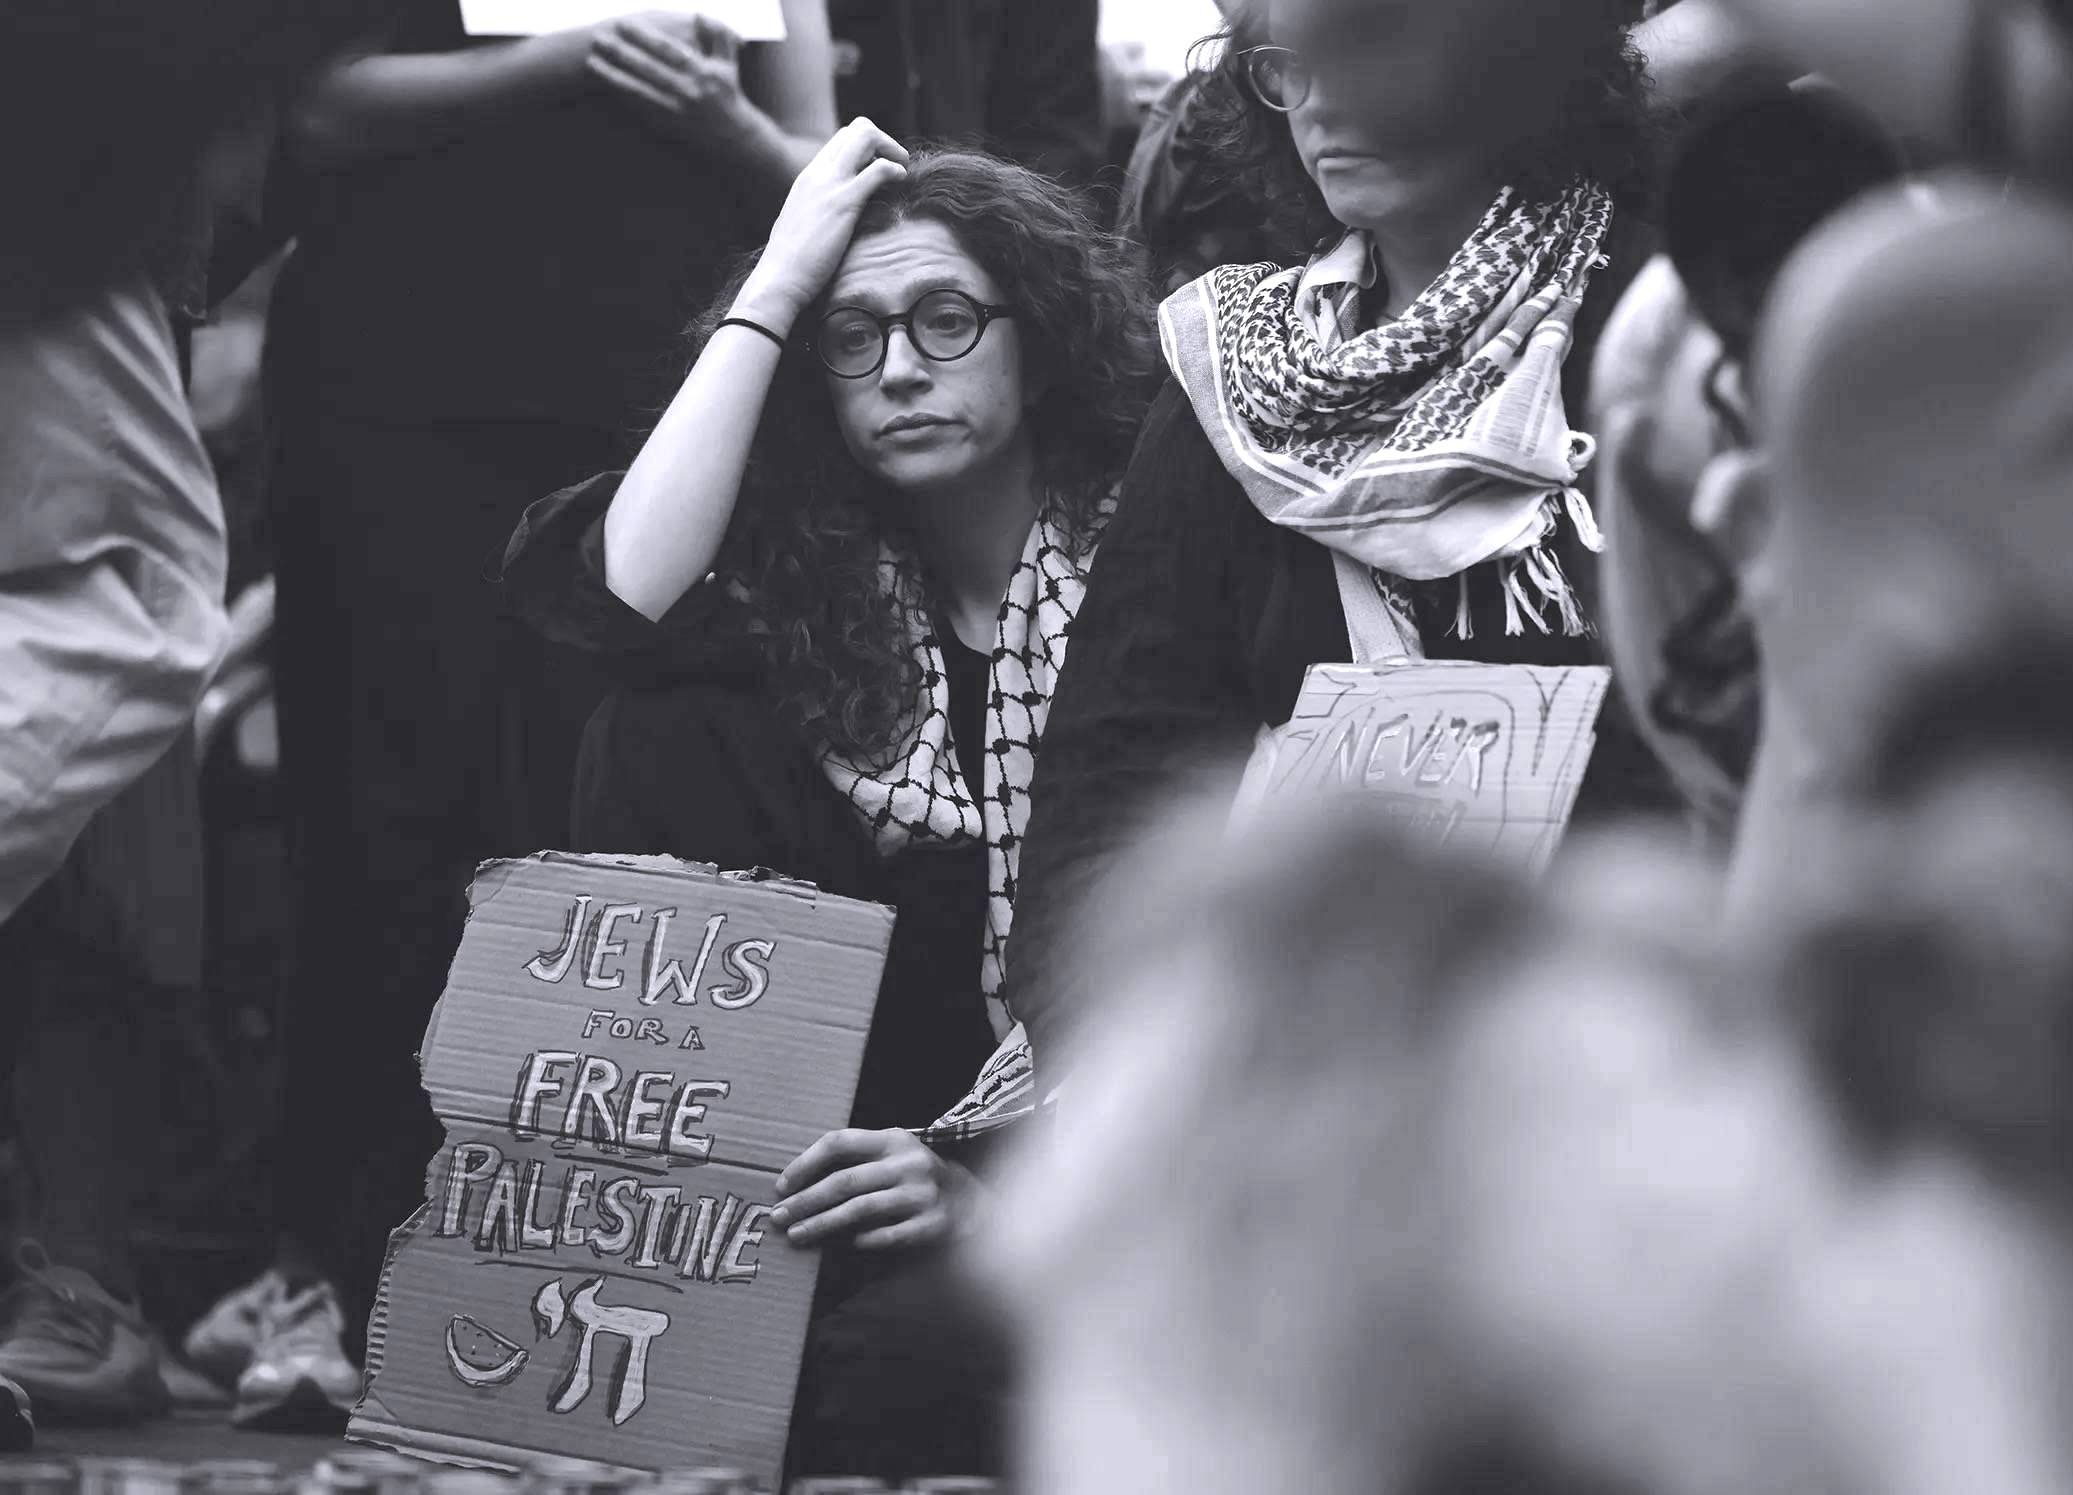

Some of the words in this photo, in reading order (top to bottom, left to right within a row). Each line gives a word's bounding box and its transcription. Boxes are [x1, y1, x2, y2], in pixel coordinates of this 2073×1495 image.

[1330, 707, 1499, 797] NEVER
[521, 894, 777, 1010] JEWS
[581, 1010, 668, 1044] FOR
[679, 1026, 705, 1050] A
[509, 1050, 730, 1165] FREE
[433, 1143, 776, 1282] PALESTINE
[531, 1277, 670, 1426] חי
